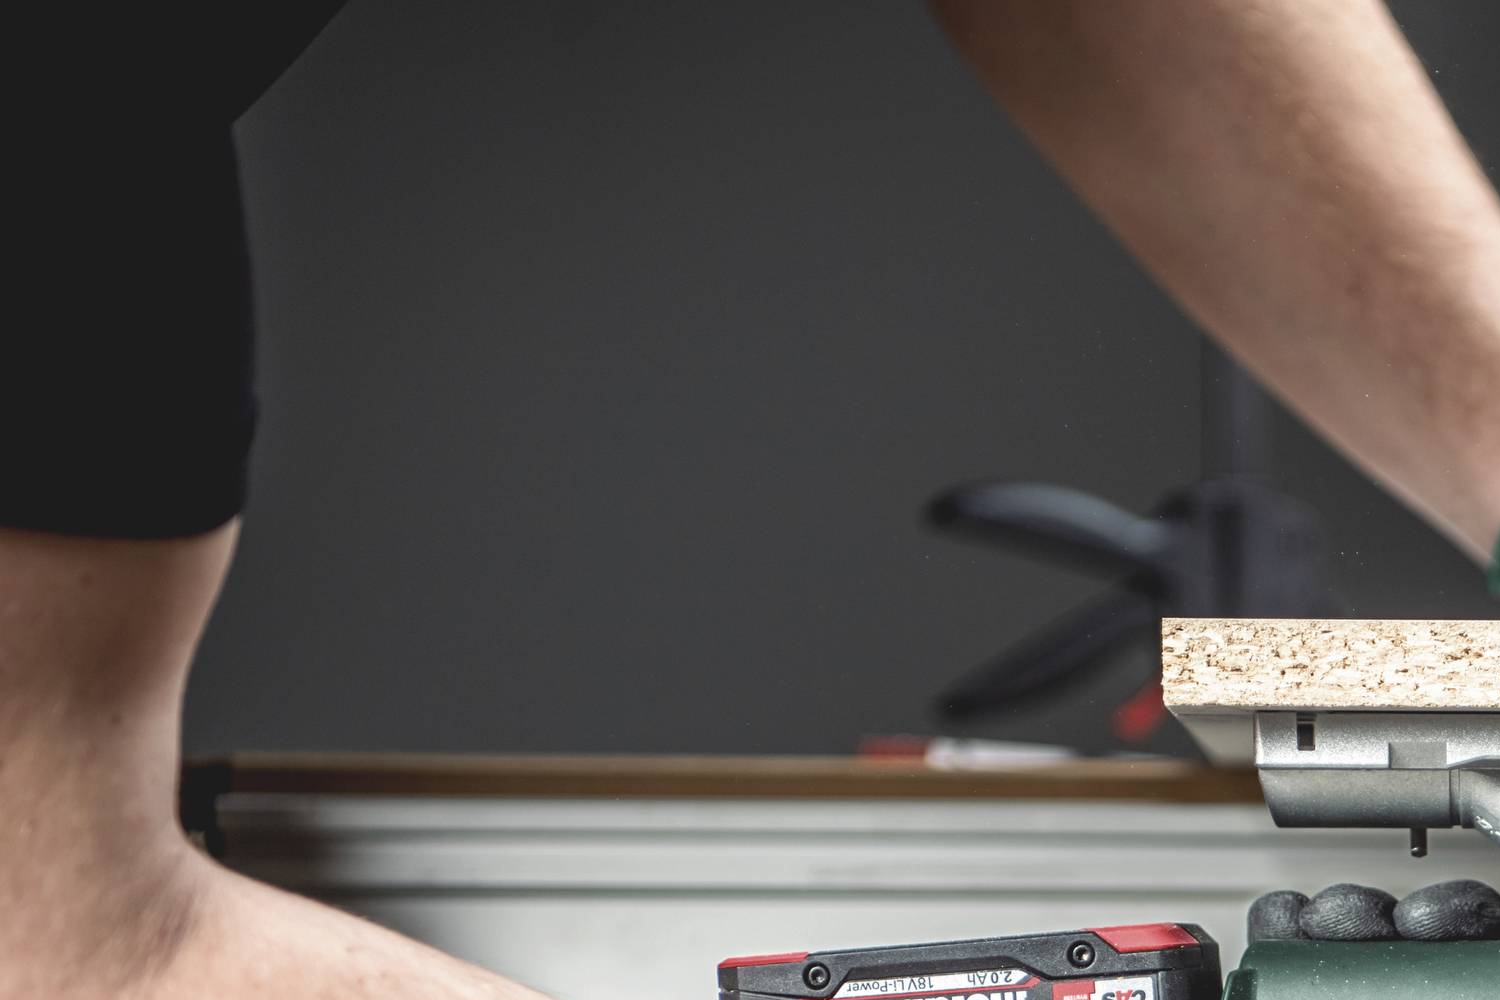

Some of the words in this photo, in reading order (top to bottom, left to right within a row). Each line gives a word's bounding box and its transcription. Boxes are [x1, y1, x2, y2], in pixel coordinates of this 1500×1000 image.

[907, 976, 933, 990] 18V
[967, 972, 988, 985] Ah
[990, 971, 1012, 984] 2.0
[847, 979, 904, 992] Li-Power
